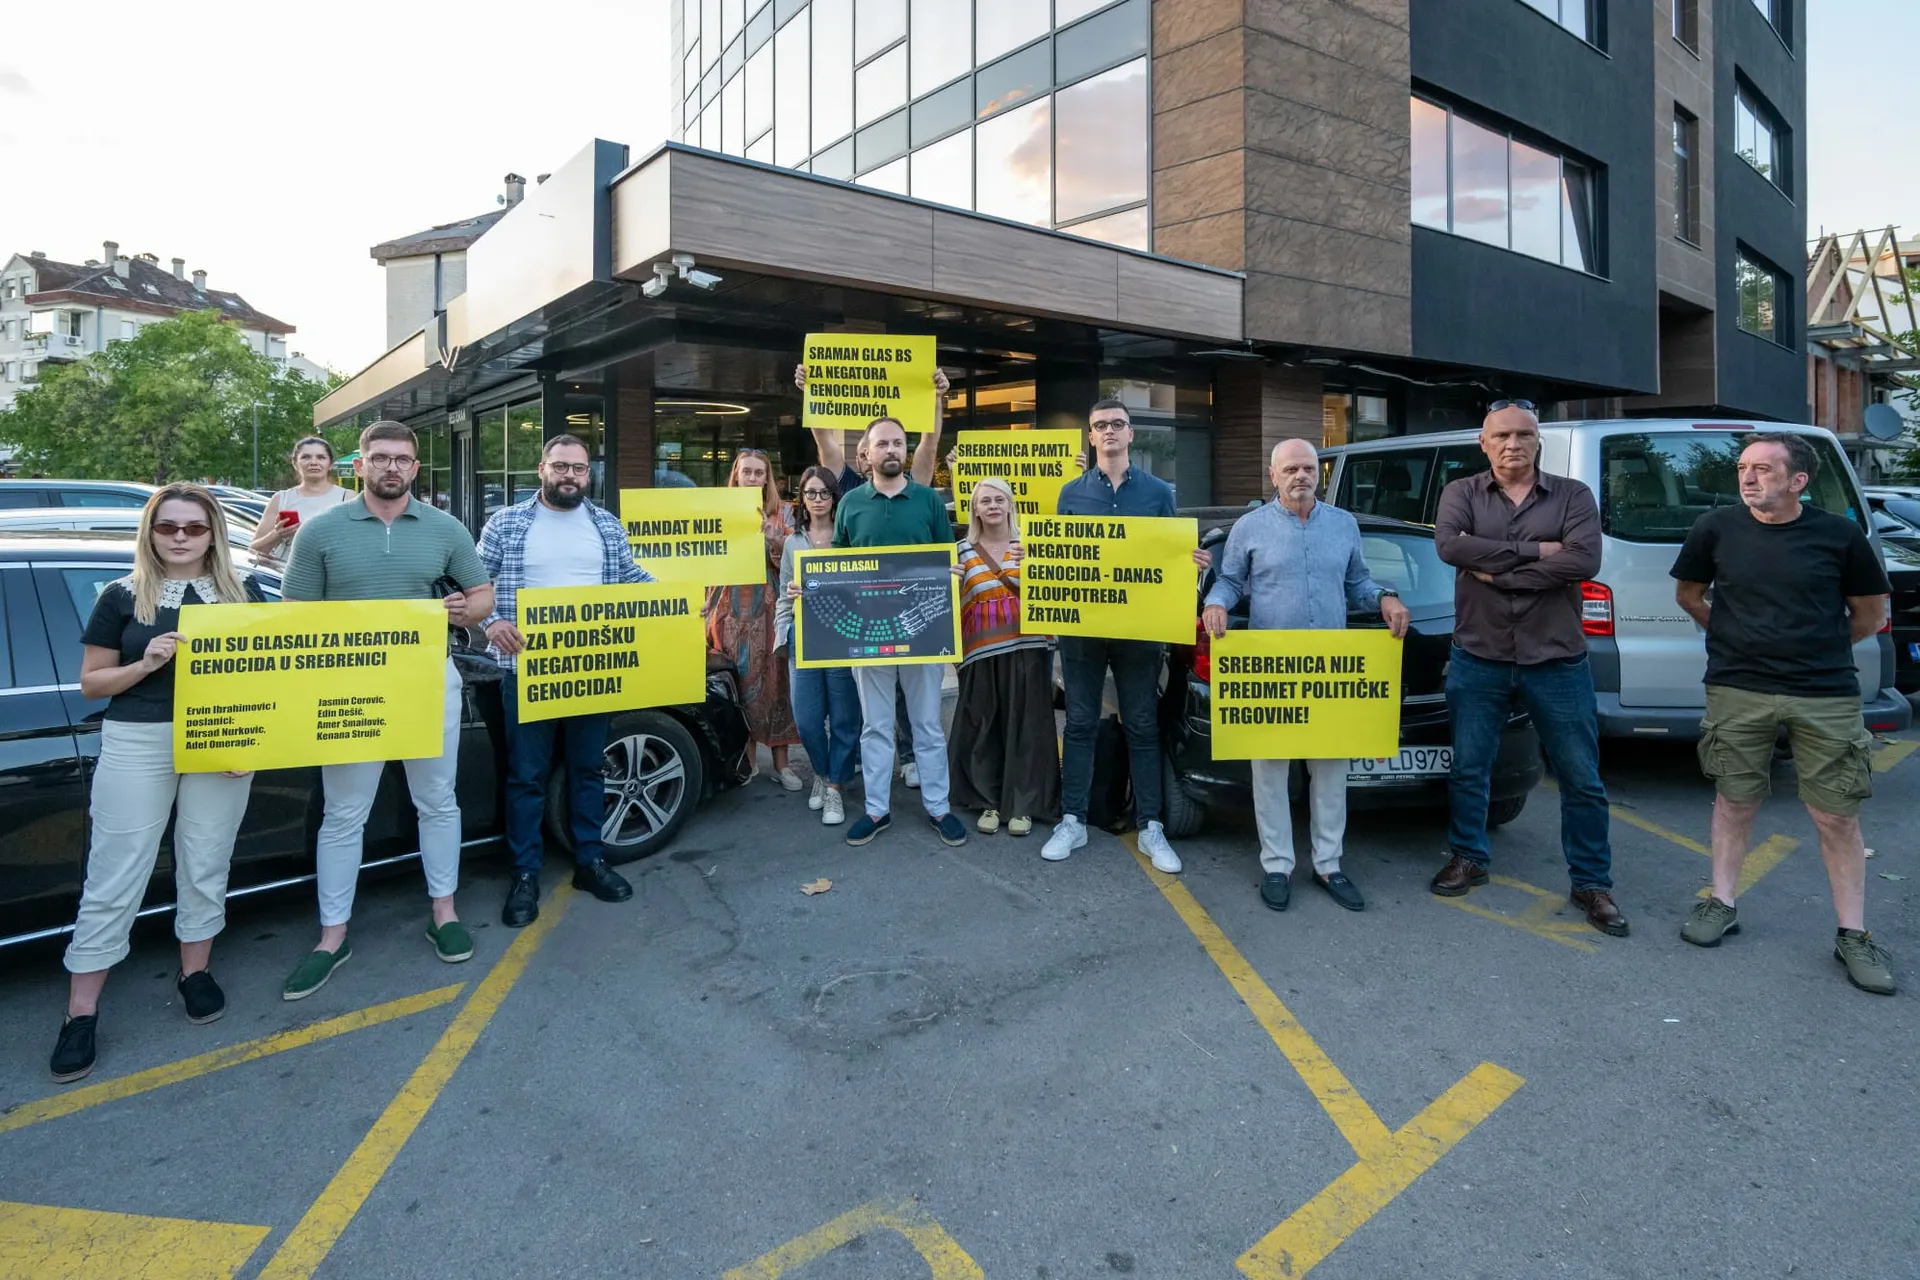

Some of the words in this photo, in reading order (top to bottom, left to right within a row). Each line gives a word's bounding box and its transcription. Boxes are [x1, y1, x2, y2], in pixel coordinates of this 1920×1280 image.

[809, 346, 860, 361] SRAMAN
[862, 348, 893, 362] GLAS
[895, 348, 912, 363] BS
[808, 365, 824, 379] ZA
[825, 366, 888, 381] NEGATORA
[810, 384, 871, 399] GENOCIDA
[873, 385, 901, 400] JOLA
[809, 400, 888, 417] VUČUROVIĆA
[957, 443, 1029, 458] SREBRENICA
[1031, 443, 1073, 458] PAMTI.
[957, 462, 1012, 477] PAMTIMO
[1014, 463, 1019, 477] I
[1021, 463, 1036, 477] MI
[1038, 460, 1063, 478] VAŠ
[1019, 481, 1028, 496] U
[627, 519, 690, 537] MANDAT
[692, 518, 723, 535] NIJE
[1027, 518, 1061, 538] JUČE
[1064, 522, 1106, 539] RUKA
[1107, 523, 1127, 540] ZA
[629, 542, 672, 559] IZNAD
[675, 539, 728, 557] ISTINE!
[1027, 543, 1101, 561] NEGATORE
[805, 562, 823, 573] ONI
[825, 561, 838, 573] SU
[840, 559, 879, 572] GLASALI
[1027, 564, 1102, 583] GENOCIDA
[1112, 567, 1163, 584] DANAS
[1027, 585, 1128, 605] ZLOUPOTREBA
[526, 604, 577, 626] NEMA
[580, 597, 690, 622] OPRAVDANJA
[1027, 603, 1081, 624] ŽRTAVA
[190, 637, 222, 654] ONI
[225, 636, 249, 652] SU
[252, 633, 318, 651] GLASALI
[320, 632, 340, 648] ZA
[343, 630, 420, 647] NEGATORA
[525, 631, 548, 652] ZA
[552, 624, 636, 650] PODRŠKU
[190, 655, 277, 676] GENOCIDA
[279, 655, 291, 671] U
[294, 651, 387, 670] SREBRENICI
[526, 650, 640, 677] NEGATORIMA
[1218, 655, 1327, 675] SREBRENICA
[1330, 655, 1366, 674] NIJE
[526, 676, 622, 704] GENOCIDA!
[1218, 681, 1298, 700] PREDMET
[1301, 677, 1390, 699] POLITIČKE
[186, 706, 212, 716] Ervin
[317, 697, 350, 708] Jasmin
[186, 716, 235, 728] poslanici:
[317, 709, 337, 719] Edin
[1218, 706, 1310, 725] TRGOVINE!
[185, 728, 220, 739] Mirsad
[316, 720, 341, 731] Amer
[185, 740, 208, 750] Adel
[316, 731, 351, 742] Kenana
